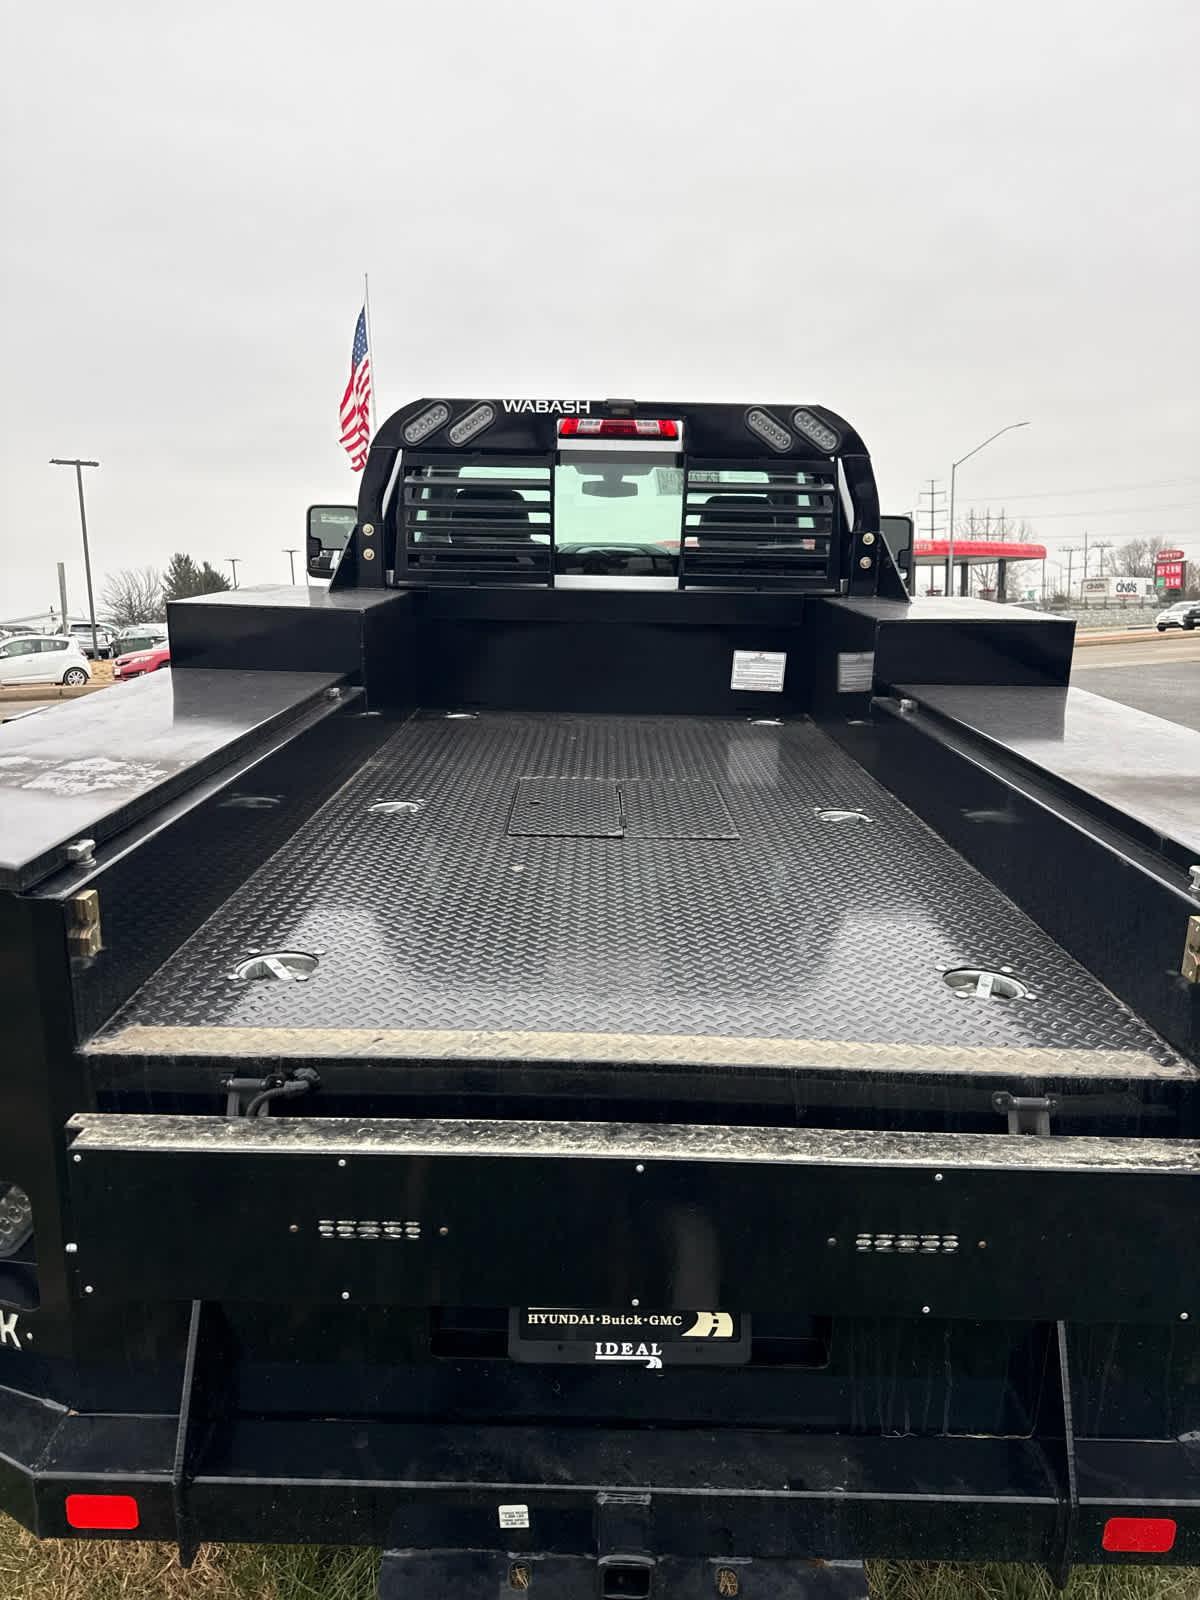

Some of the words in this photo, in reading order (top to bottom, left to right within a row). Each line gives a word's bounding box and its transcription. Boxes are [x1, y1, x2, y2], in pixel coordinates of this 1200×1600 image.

[502, 400, 590, 414] WABASH
[527, 1314, 595, 1325] HYUNDAI
[601, 1314, 643, 1326] Buick
[649, 1315, 683, 1326] GMC
[594, 1341, 663, 1356] IDEAL
